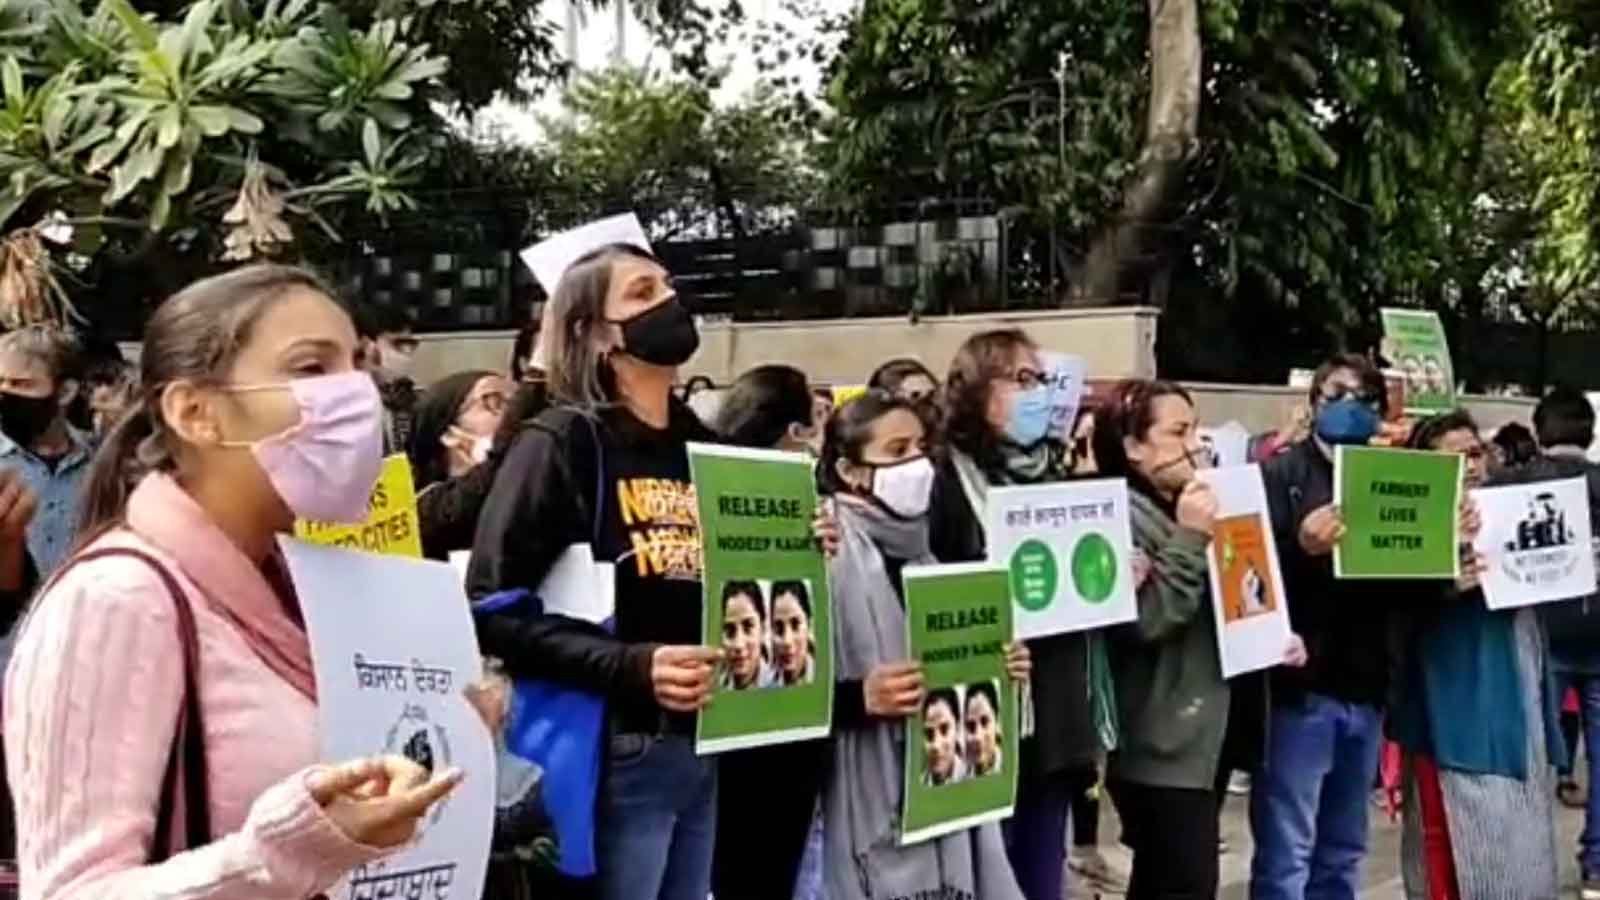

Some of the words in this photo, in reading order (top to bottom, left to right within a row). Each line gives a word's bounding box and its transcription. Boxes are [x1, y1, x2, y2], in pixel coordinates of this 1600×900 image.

[718, 496, 802, 519] RELEASE
[1379, 506, 1417, 522] LIVES
[1370, 533, 1423, 550] MATTER
[925, 605, 999, 632] RELEASE
